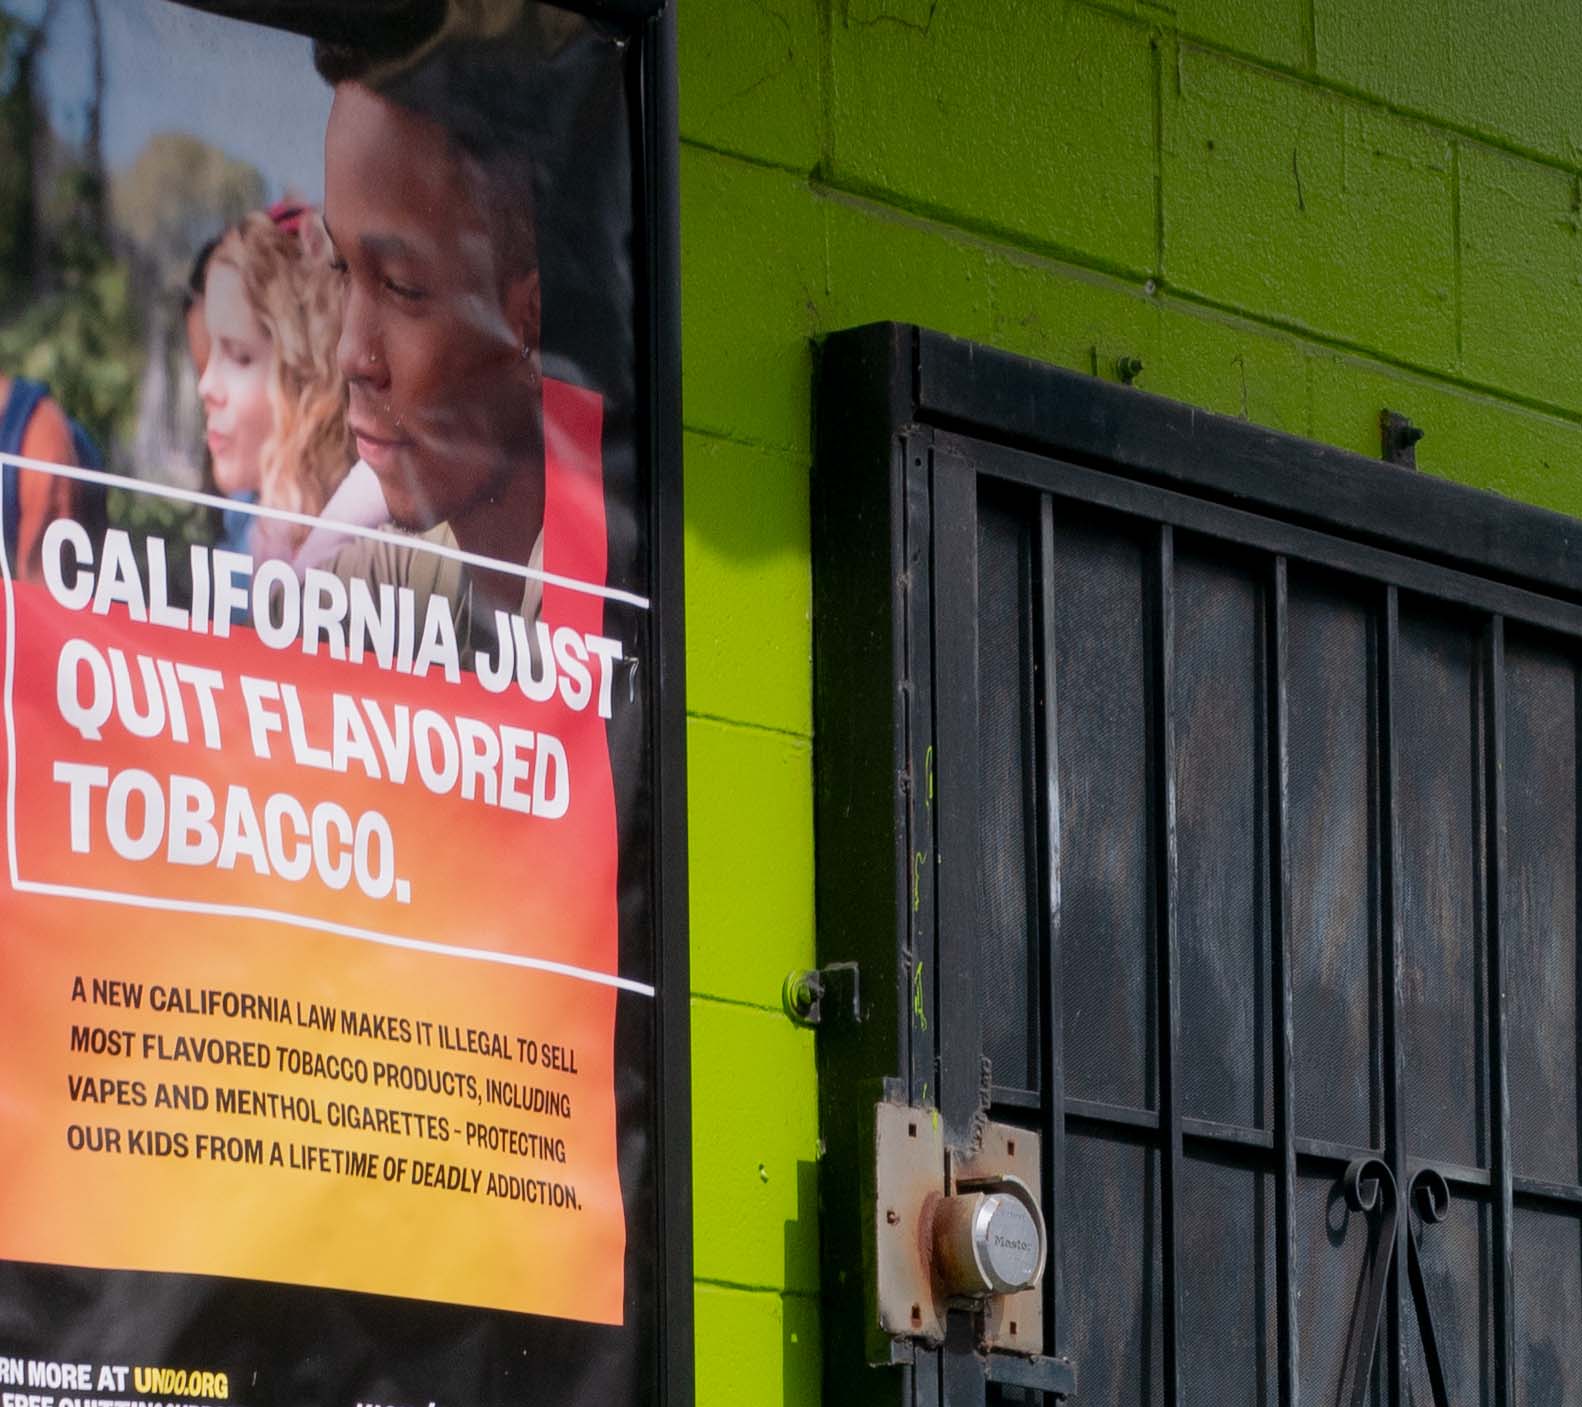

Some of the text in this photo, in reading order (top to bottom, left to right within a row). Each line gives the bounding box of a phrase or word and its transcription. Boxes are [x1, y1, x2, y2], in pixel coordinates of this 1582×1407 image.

[42, 518, 622, 720] CALIFORNIA JUST
[57, 638, 570, 819] QUIT FLAVORED
[53, 761, 411, 904] TOBACCO.
[71, 976, 578, 1074] A NEW CALIFORNIA LAW MAKES IT ILLEGAL TO SELL
[71, 1025, 571, 1119] MOST FLAVORED TOBACCO PRODUCTS, INCLUDING
[68, 1075, 147, 1106] VAPES
[154, 1083, 208, 1111] AND
[216, 1087, 322, 1124] MENTHOL
[327, 1102, 449, 1141] CIGARETTES
[466, 1122, 566, 1164] PROTECTING
[67, 1125, 582, 1211] OUR KIDS FROM A LIFETIME OF DEADLY ADDICTION.
[28, 1360, 92, 1391] MORE
[97, 1365, 129, 1392] AT
[134, 1367, 229, 1399] UNDO.ORG
